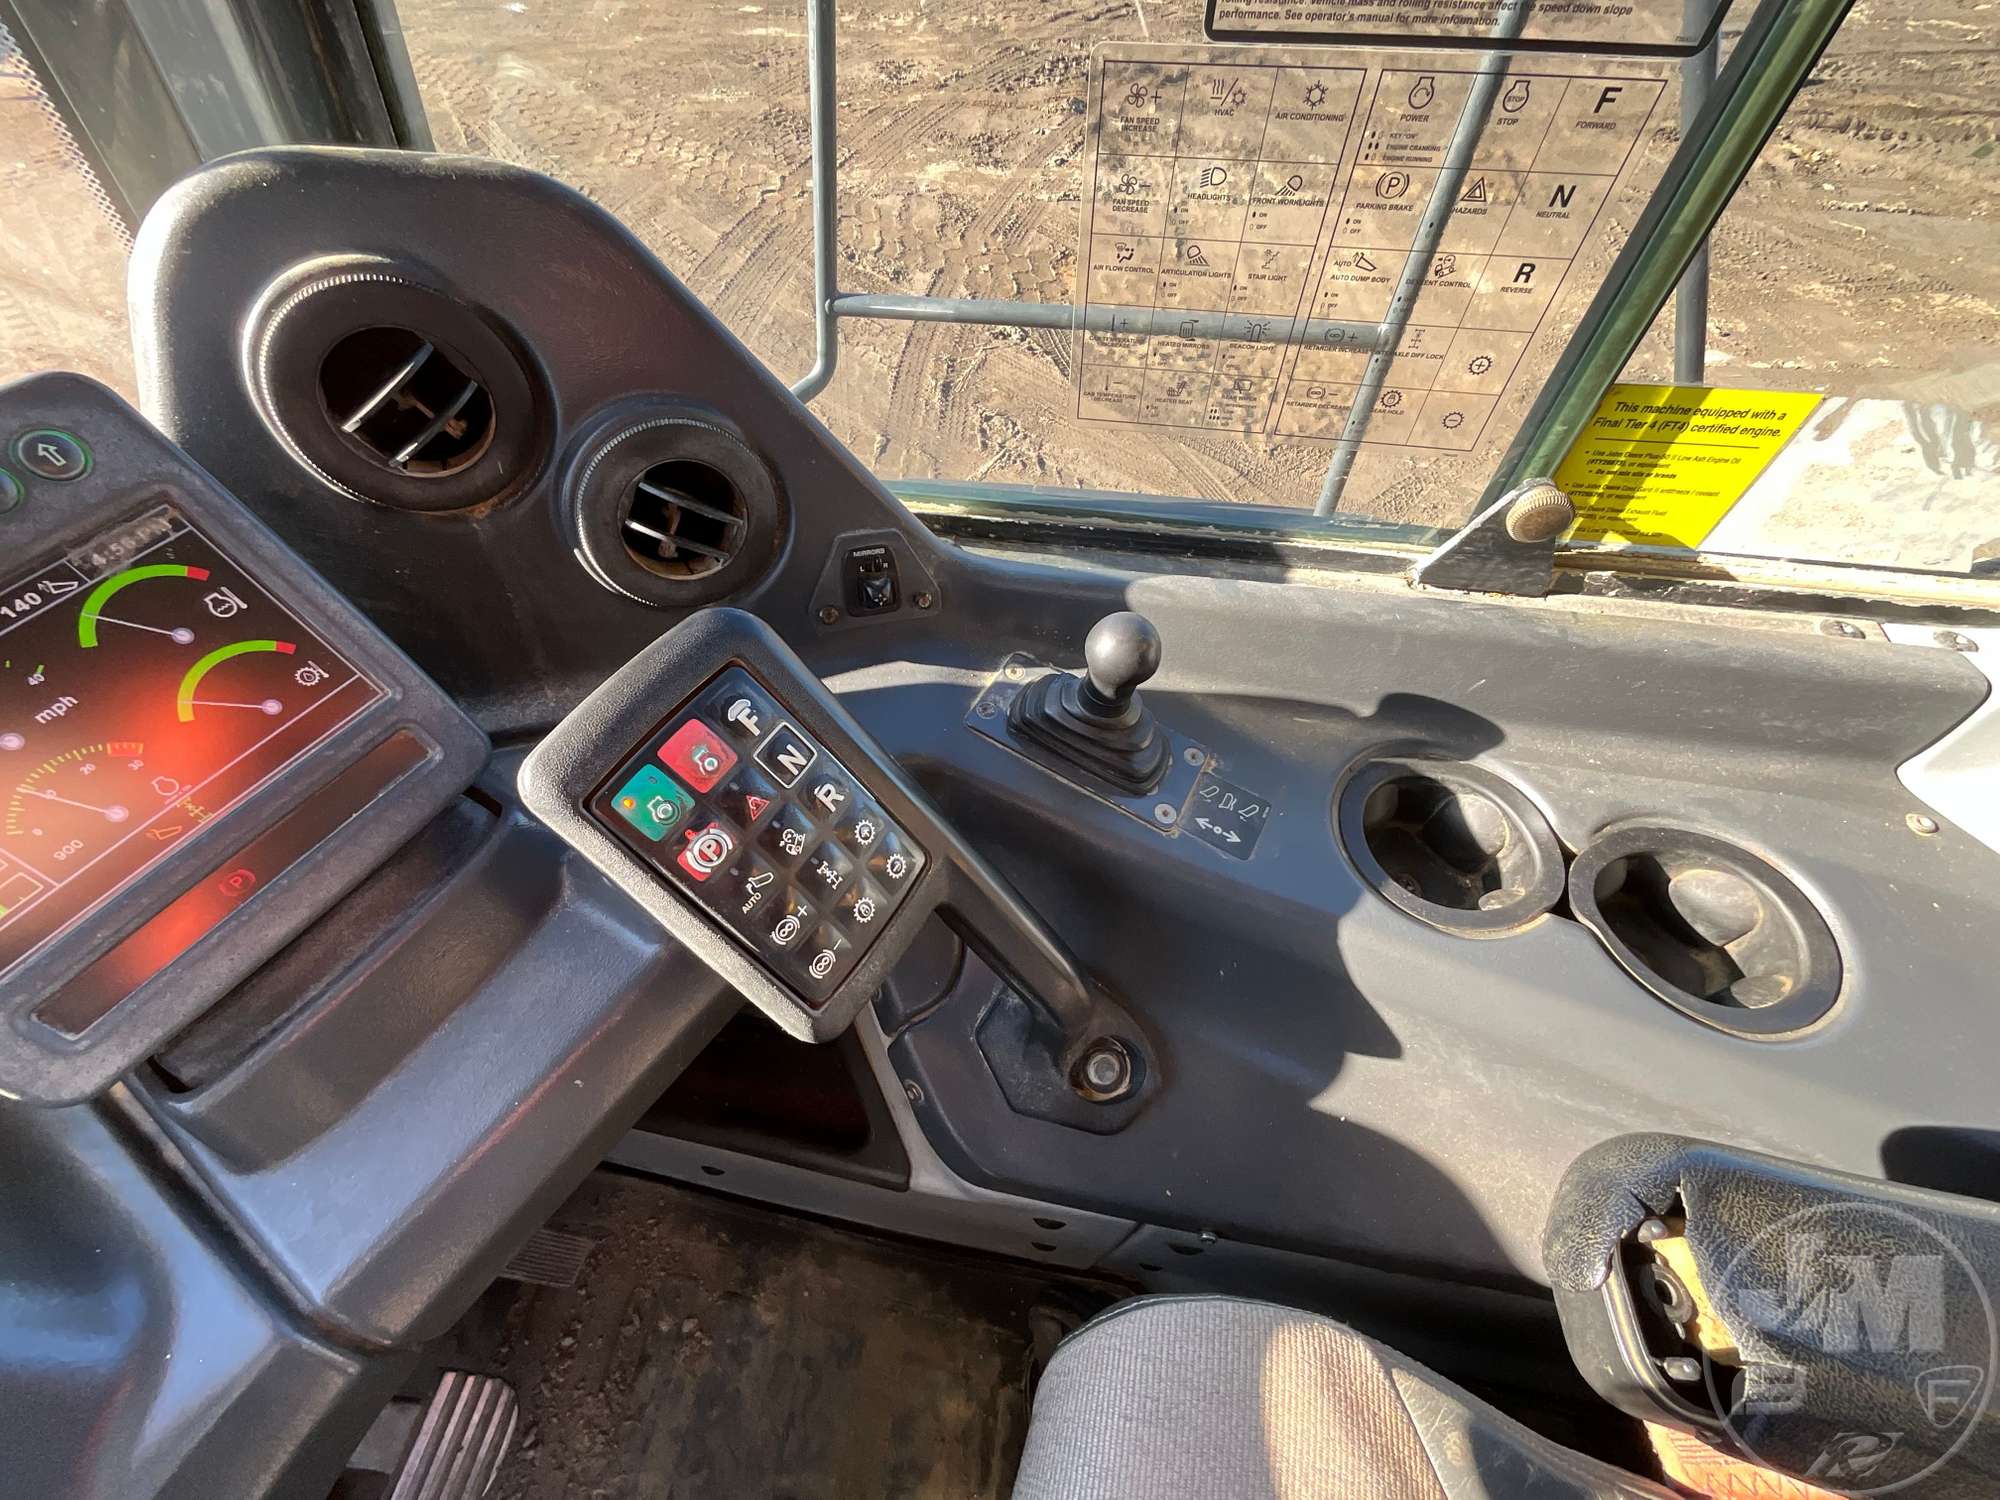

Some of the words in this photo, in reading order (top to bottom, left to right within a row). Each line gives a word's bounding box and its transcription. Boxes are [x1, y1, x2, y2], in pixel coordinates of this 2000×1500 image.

[1397, 0, 1430, 10] rolling
[1432, 0, 1485, 10] resistance
[1538, 3, 1571, 15] speed
[1572, 3, 1601, 14] down
[1603, 5, 1633, 17] slope
[1219, 8, 1281, 20] performance.
[1284, 9, 1303, 20] See
[1305, 11, 1355, 22] operator's
[1357, 12, 1394, 22] manual
[1395, 13, 1410, 25] for
[1411, 14, 1438, 24] more
[1439, 14, 1501, 27] information.
[1593, 86, 1623, 114] F
[1120, 116, 1134, 124] FAN
[1136, 117, 1160, 125] SPEED
[1275, 112, 1288, 120] AIR
[1289, 113, 1345, 122] CONDITIONING
[1400, 114, 1430, 122] POWER
[1497, 118, 1519, 126] STOP
[1575, 121, 1617, 130] FORWARD
[1187, 192, 1231, 201] HEADLIGHTS
[1252, 197, 1276, 205] FRONT
[1549, 184, 1577, 208] N
[1112, 205, 1149, 214] DECREASE
[1356, 202, 1387, 211] PARKING
[1388, 203, 1414, 212] BRAKE
[1536, 210, 1571, 219] NEUTRAL
[1124, 266, 1155, 274] CONTROL
[1161, 268, 1208, 278] ARTICULATION
[1208, 270, 1232, 279] LIGHTS
[1513, 262, 1537, 284] R
[1248, 273, 1267, 281] STAIR
[1267, 274, 1288, 282] LIGHT
[1371, 276, 1392, 284] BODY
[1439, 279, 1472, 288] CONTROL
[1500, 286, 1534, 295] REVERSE
[1425, 353, 1445, 361] LOCK
[1614, 402, 1638, 413] This
[1640, 404, 1691, 416] machine
[1692, 407, 1751, 420] equipped
[1752, 409, 1777, 420] with
[1778, 412, 1787, 421] a
[1593, 417, 1624, 429] Final
[1625, 418, 1648, 430] Tier
[1648, 420, 1657, 429] 4
[1657, 420, 1690, 433] (FT4)
[1690, 422, 1742, 435] certified
[1740, 426, 1782, 438] engine.
[1, 592, 42, 618] 140
[28, 672, 46, 686] 40
[34, 695, 79, 725] mph
[736, 706, 761, 737] F
[128, 758, 145, 772] 30
[777, 743, 808, 776] N
[79, 762, 97, 776] 20
[814, 783, 845, 813] R
[53, 838, 85, 861] 900
[741, 891, 763, 915] AUTO
